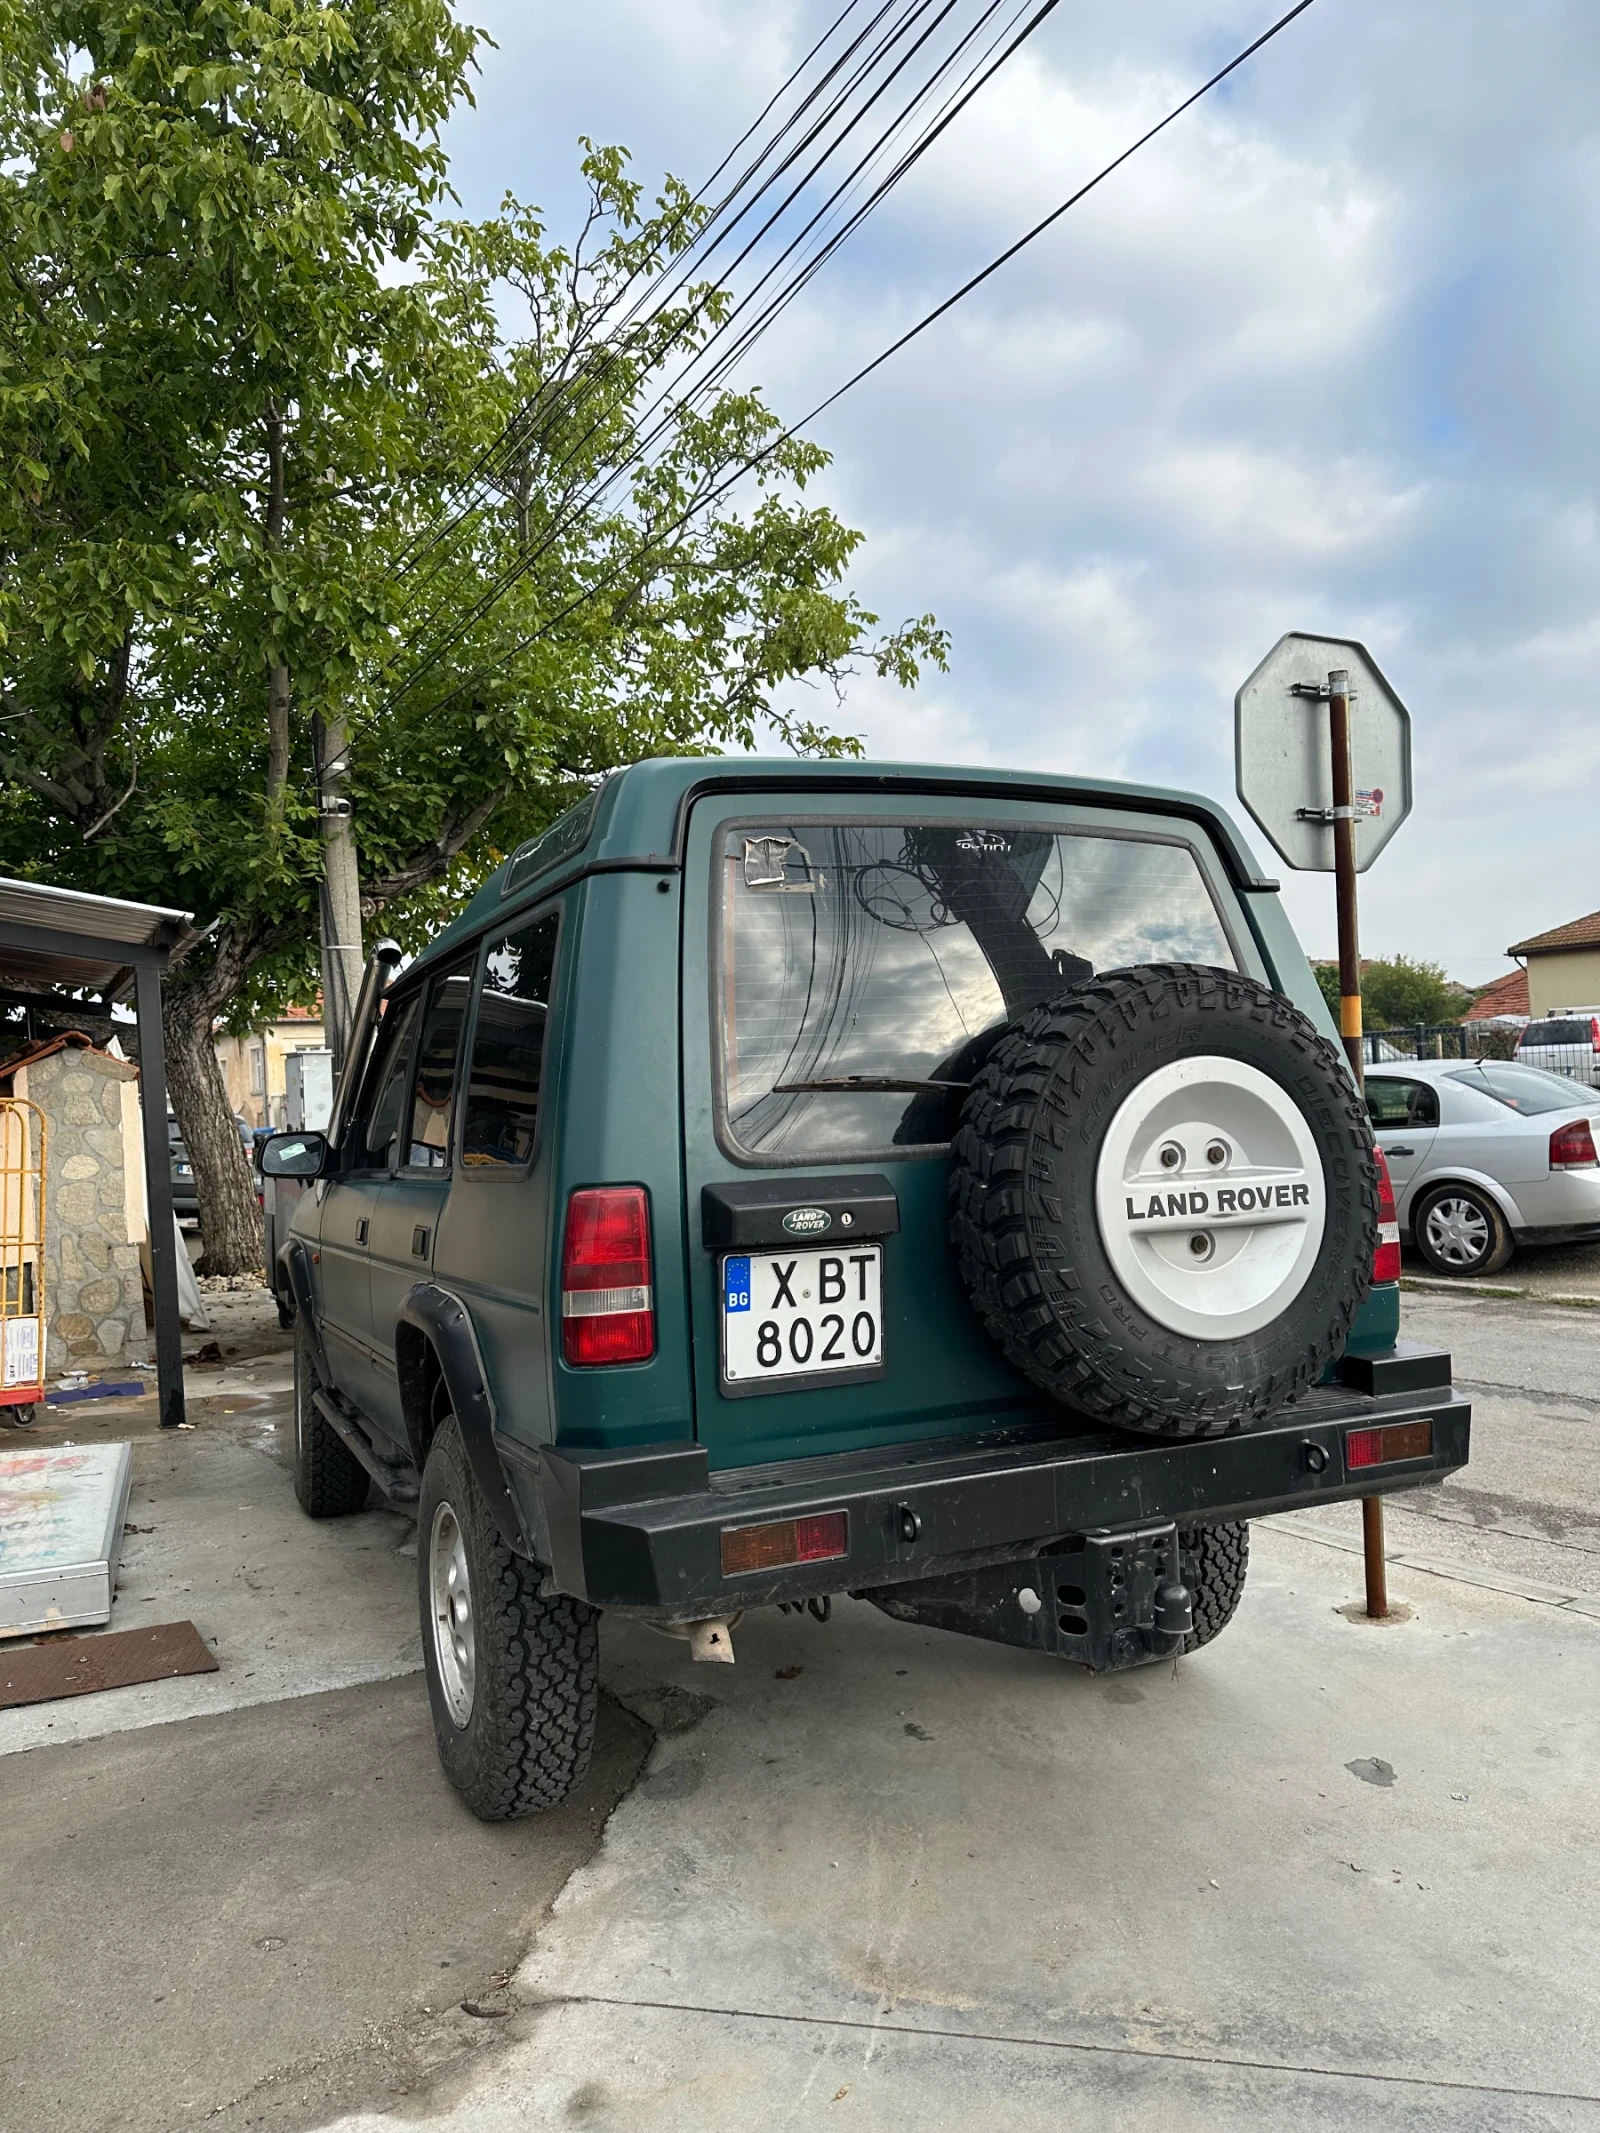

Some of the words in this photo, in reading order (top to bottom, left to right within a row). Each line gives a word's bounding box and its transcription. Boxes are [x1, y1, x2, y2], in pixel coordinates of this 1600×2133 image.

[1080, 1023, 1202, 1145] COOPER
[792, 1212, 817, 1222] LAND
[1126, 1189, 1209, 1220] LAND
[1217, 1183, 1310, 1212] ROVER
[1293, 1075, 1352, 1313] DISCOVERER
[795, 1219, 825, 1230] ROVER
[728, 1292, 749, 1308] BG
[771, 1260, 798, 1309] X
[819, 1254, 876, 1304] BT
[756, 1311, 876, 1367] 8020
[1099, 1283, 1149, 1342] PRO
